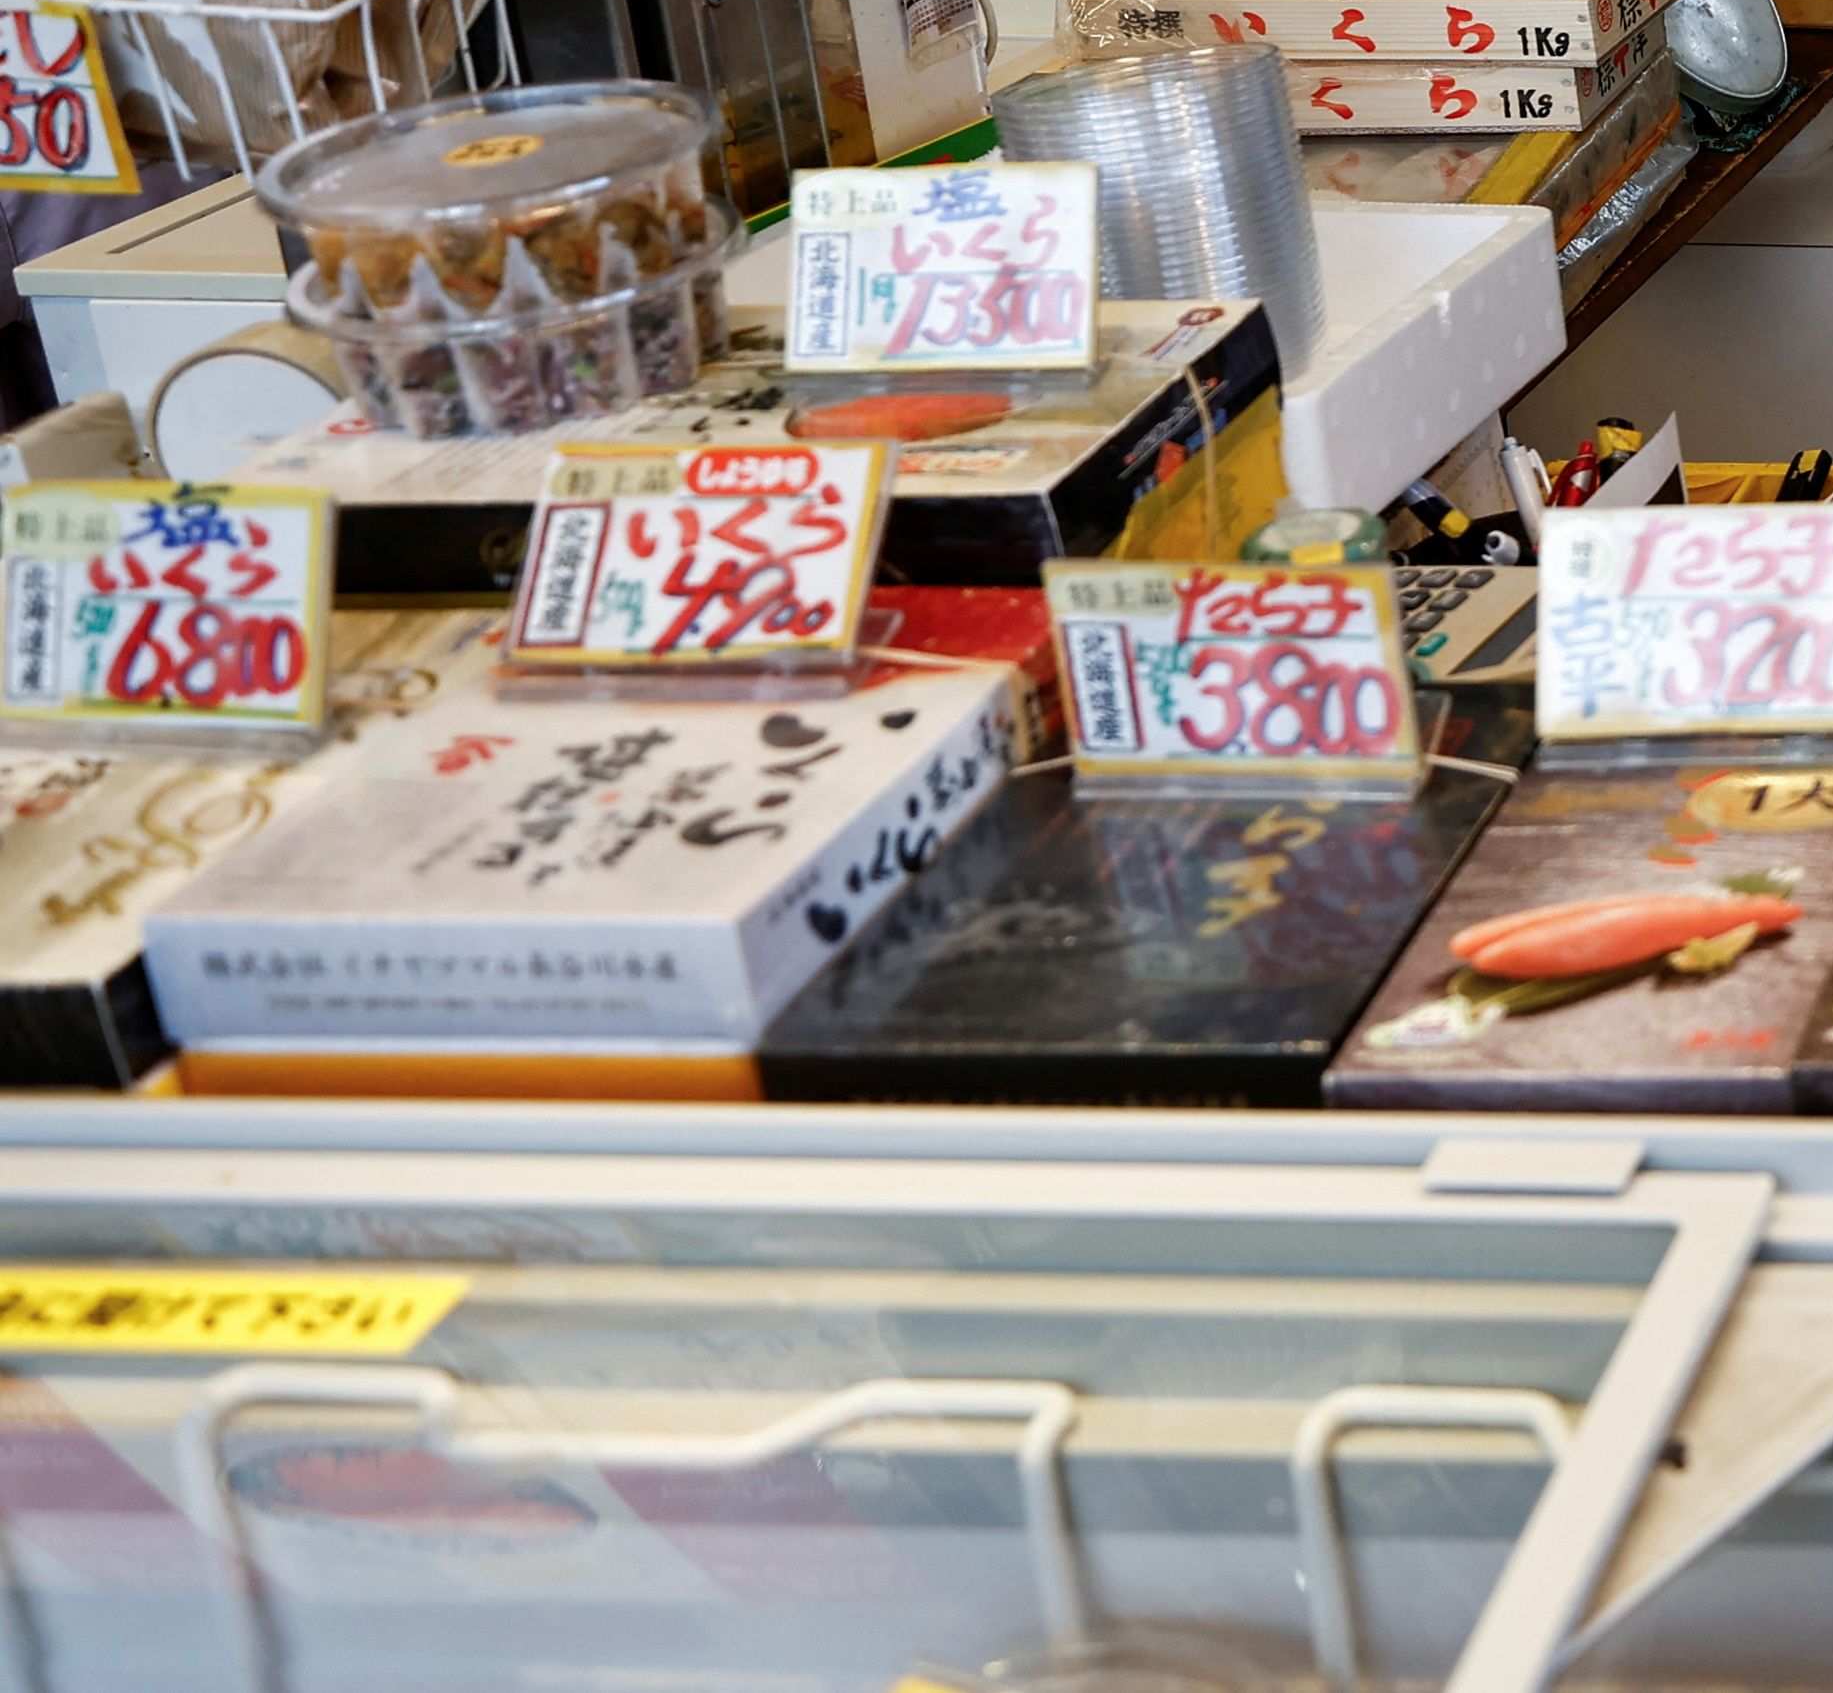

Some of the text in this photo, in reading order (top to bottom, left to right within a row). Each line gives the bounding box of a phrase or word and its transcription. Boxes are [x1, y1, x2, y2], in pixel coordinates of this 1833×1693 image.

[1208, 6, 1496, 54] いくら
[1517, 26, 1571, 57] 1Kg
[809, 188, 897, 218] 特上品
[913, 169, 1007, 223] 塩
[890, 193, 1060, 274] いくら
[810, 239, 838, 350] 北海道産
[121, 482, 240, 550] 塩
[564, 465, 669, 495] 特上品
[13, 514, 114, 545] 特上品
[626, 484, 851, 558] いくら
[88, 518, 281, 600] いくら
[526, 510, 602, 643] 北海道産
[1068, 578, 1172, 606] 特上品
[17, 557, 58, 699] 北海道産
[1174, 568, 1363, 641] たら子
[1549, 592, 1626, 718] 古平
